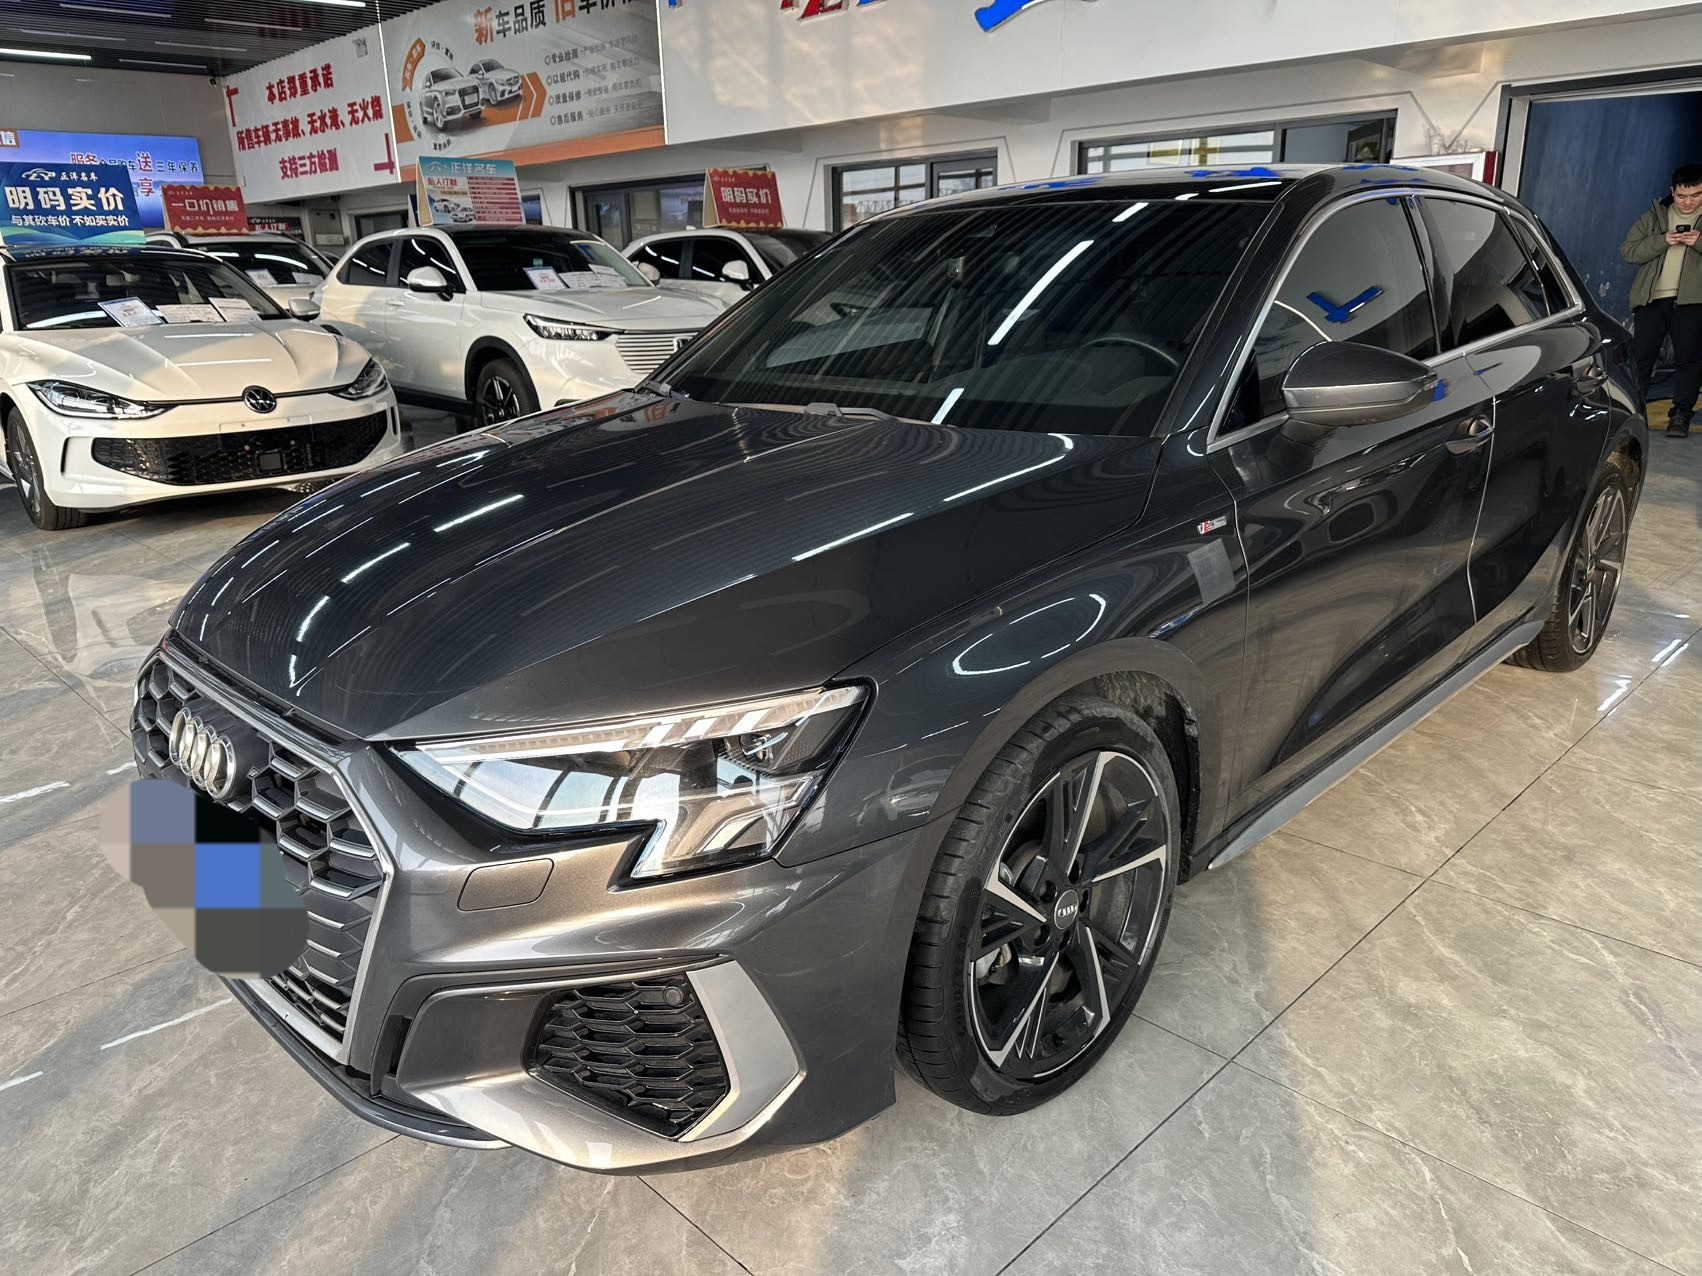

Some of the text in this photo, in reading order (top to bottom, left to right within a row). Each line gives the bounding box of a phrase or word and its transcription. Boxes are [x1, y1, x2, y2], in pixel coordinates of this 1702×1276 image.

[473, 1, 547, 46] 新车品质
[266, 62, 335, 105] 本店郑重承诺
[278, 147, 340, 180] 支持三方检测
[450, 162, 497, 175] 正洋名车
[60, 171, 98, 182] 正洋名车
[4, 186, 125, 211] 明码实价
[720, 186, 772, 204] 明码实价
[171, 198, 239, 215] 一口价销售
[11, 214, 129, 227] 与其砍车价 不如买实价
